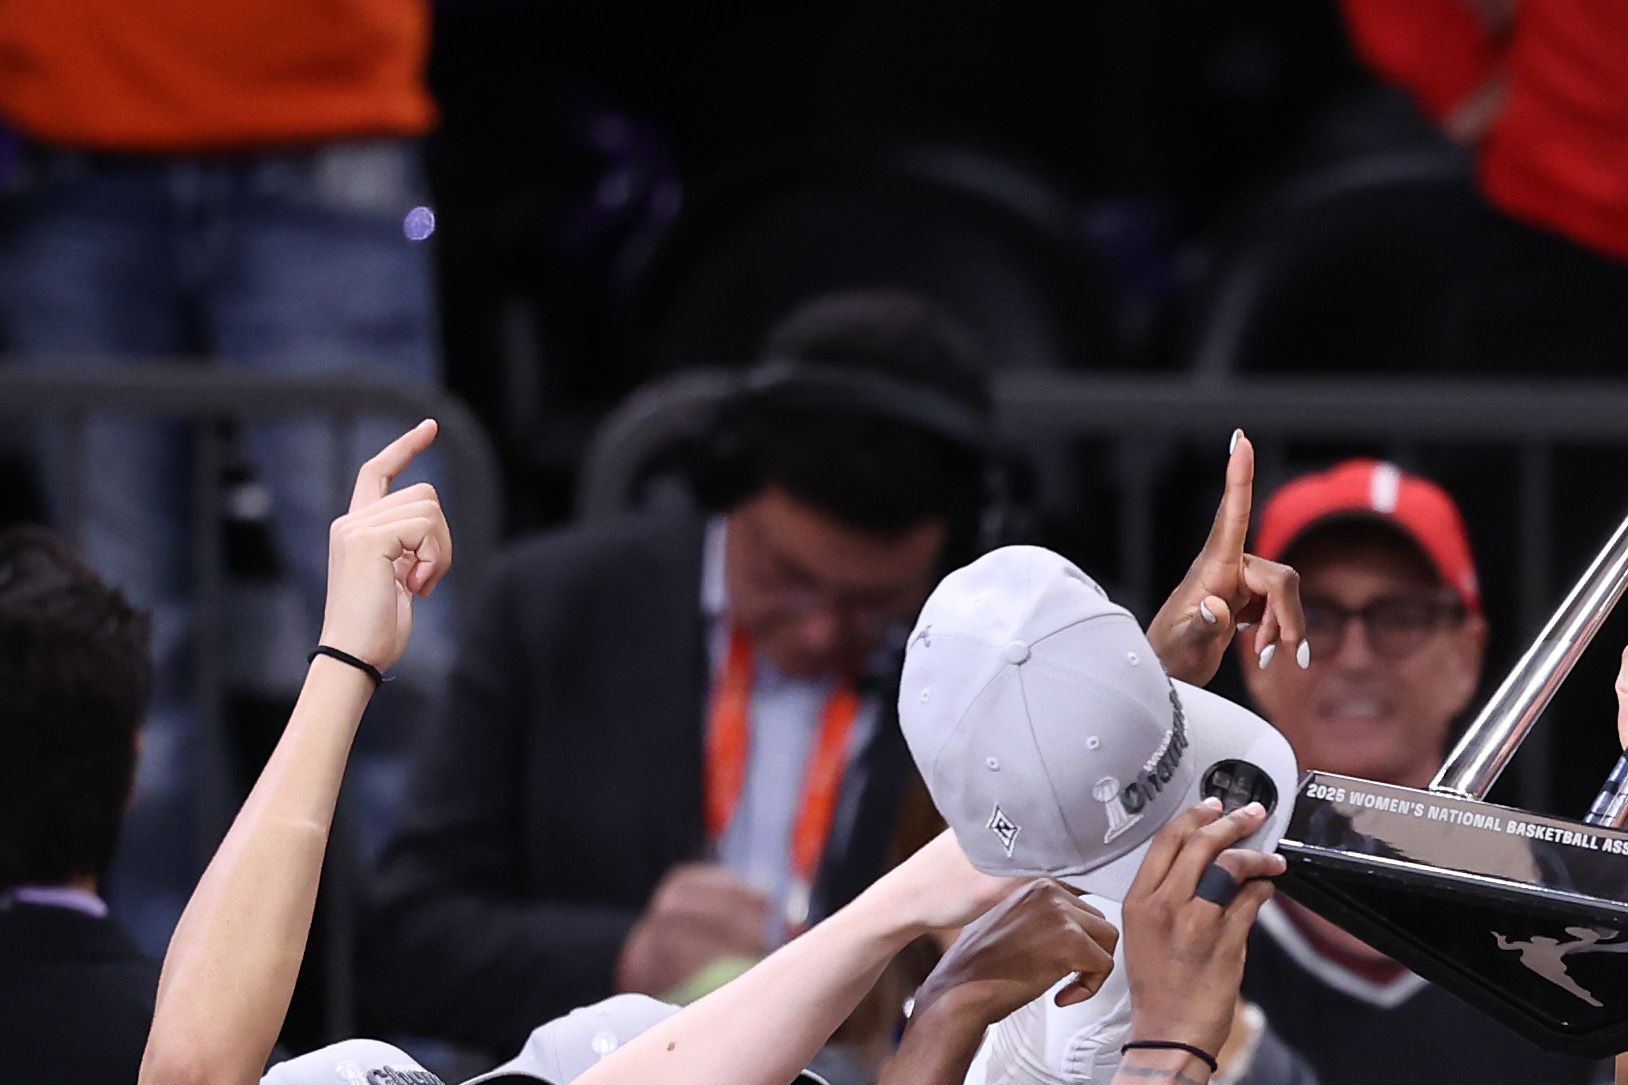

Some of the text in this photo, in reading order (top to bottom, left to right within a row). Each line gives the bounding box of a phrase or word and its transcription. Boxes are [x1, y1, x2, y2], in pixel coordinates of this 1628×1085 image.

[1306, 783, 1346, 803] 2025
[1349, 790, 1425, 818] WOMEN'S
[1427, 806, 1502, 832] NATIONAL
[1506, 821, 1600, 850] BASKETBALL
